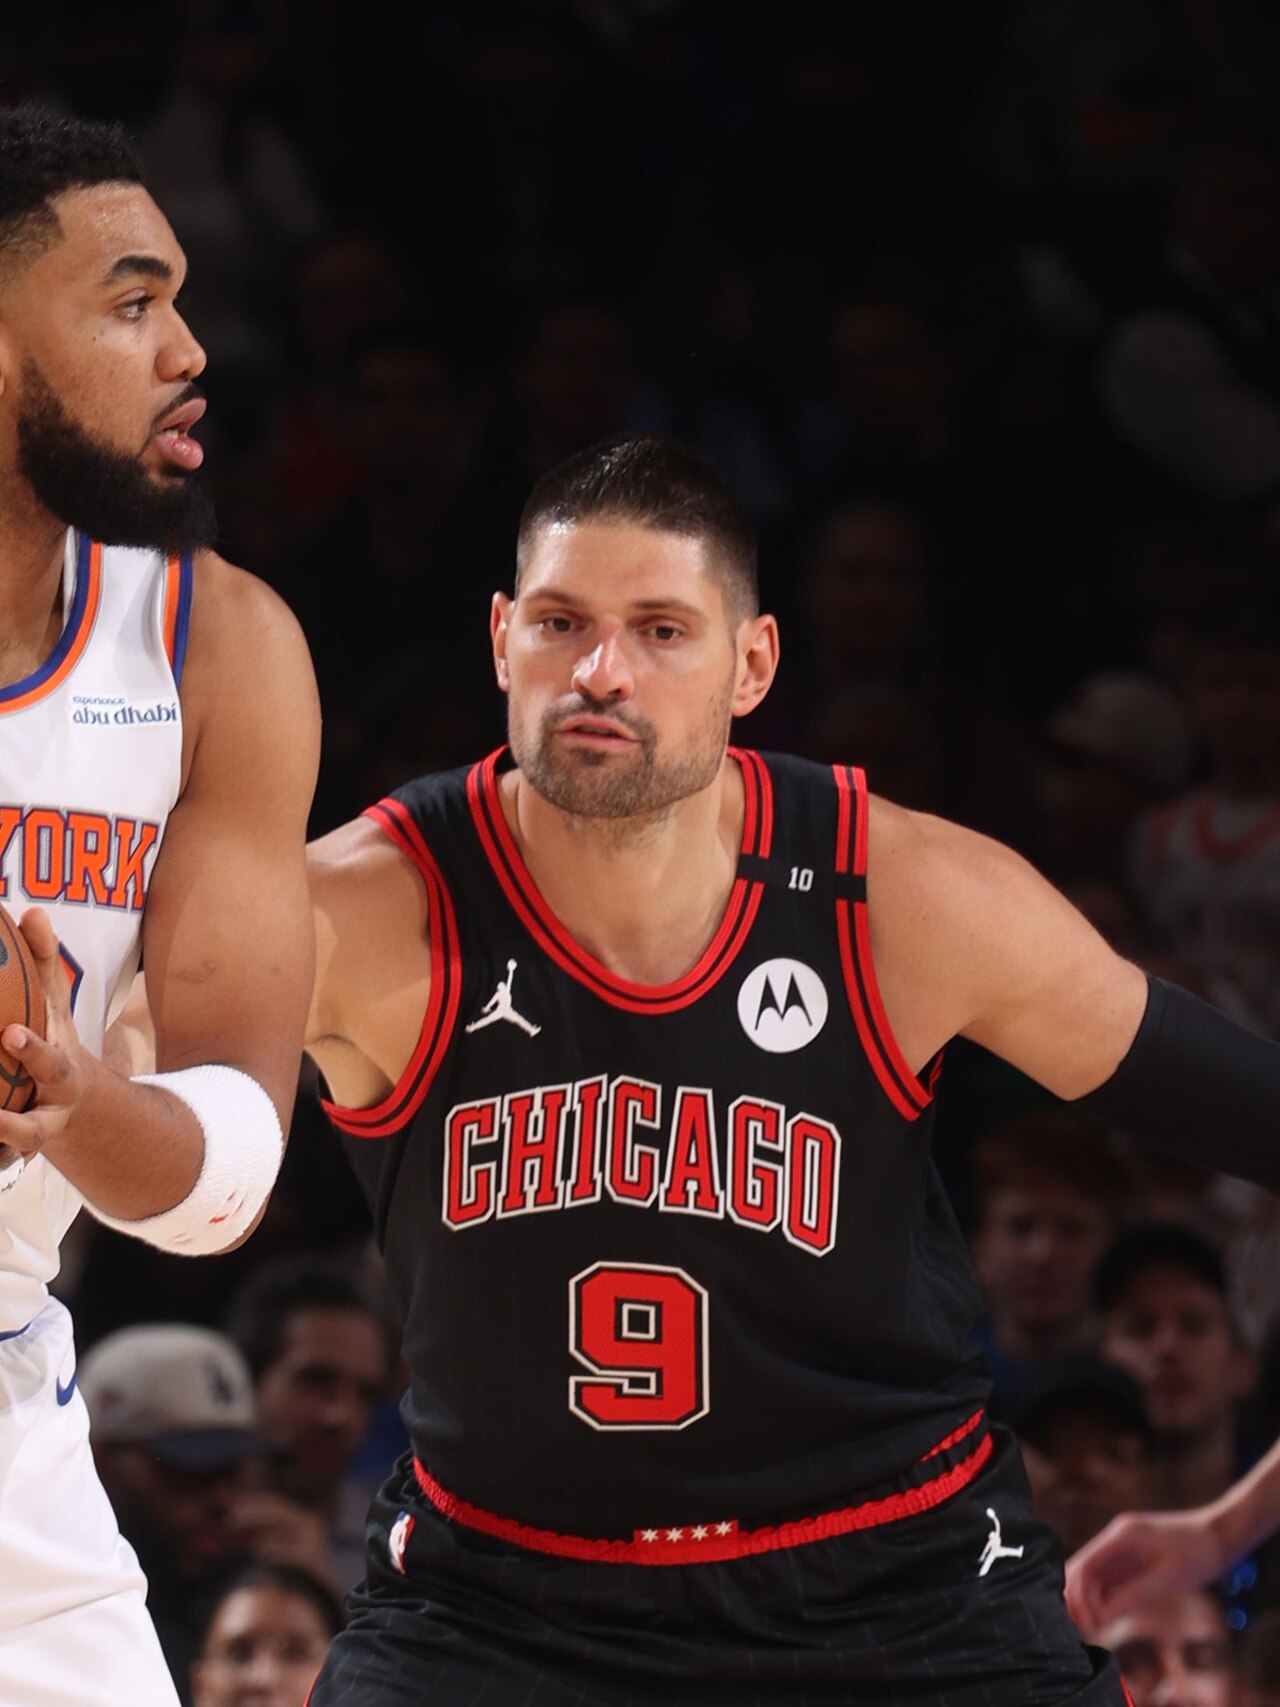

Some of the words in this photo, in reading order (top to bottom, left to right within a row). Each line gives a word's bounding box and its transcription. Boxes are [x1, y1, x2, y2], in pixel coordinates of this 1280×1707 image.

[72, 706, 111, 725] abu
[113, 702, 177, 725] dhabi
[788, 865, 814, 892] 10
[442, 1073, 842, 1258] CHICAGO
[568, 1261, 710, 1431] 9
